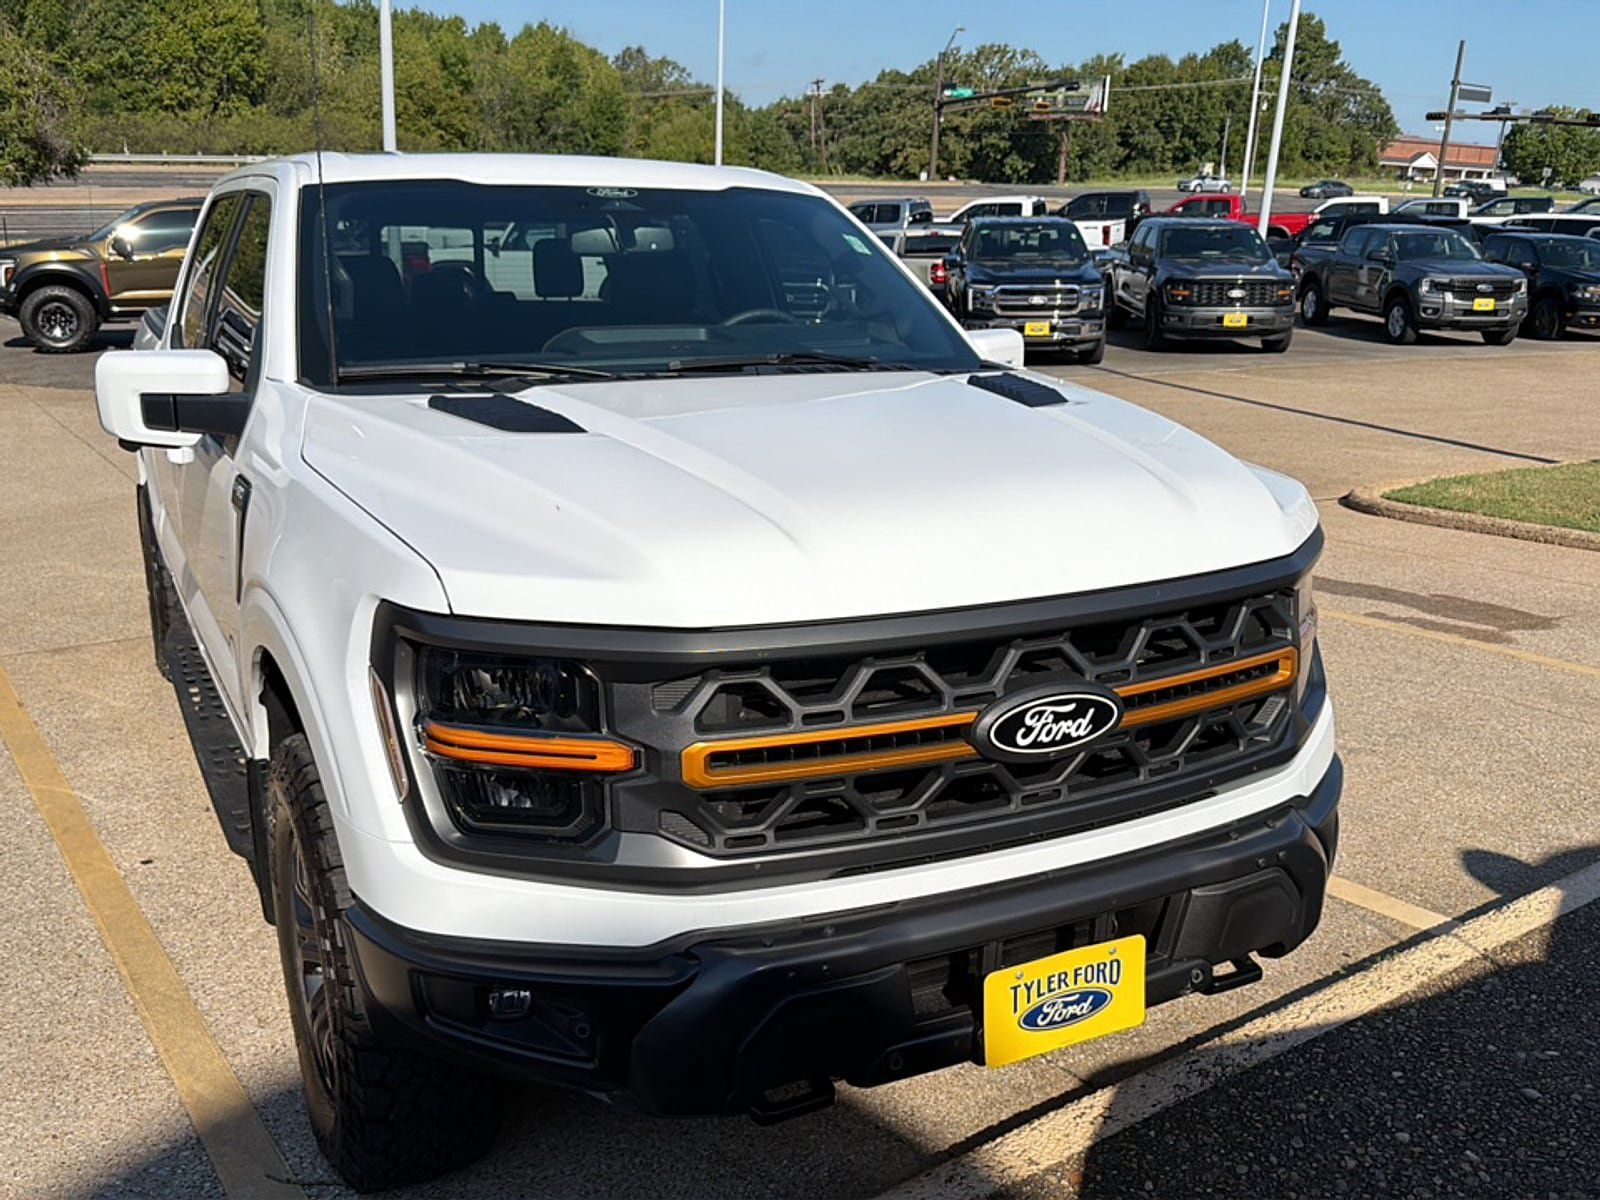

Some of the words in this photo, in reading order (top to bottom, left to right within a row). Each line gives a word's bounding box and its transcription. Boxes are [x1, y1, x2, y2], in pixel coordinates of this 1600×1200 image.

[1016, 702, 1095, 747] Ford
[1010, 971, 1070, 1015] TYLER
[1074, 958, 1121, 986] FORD
[1037, 993, 1094, 1026] Ford
